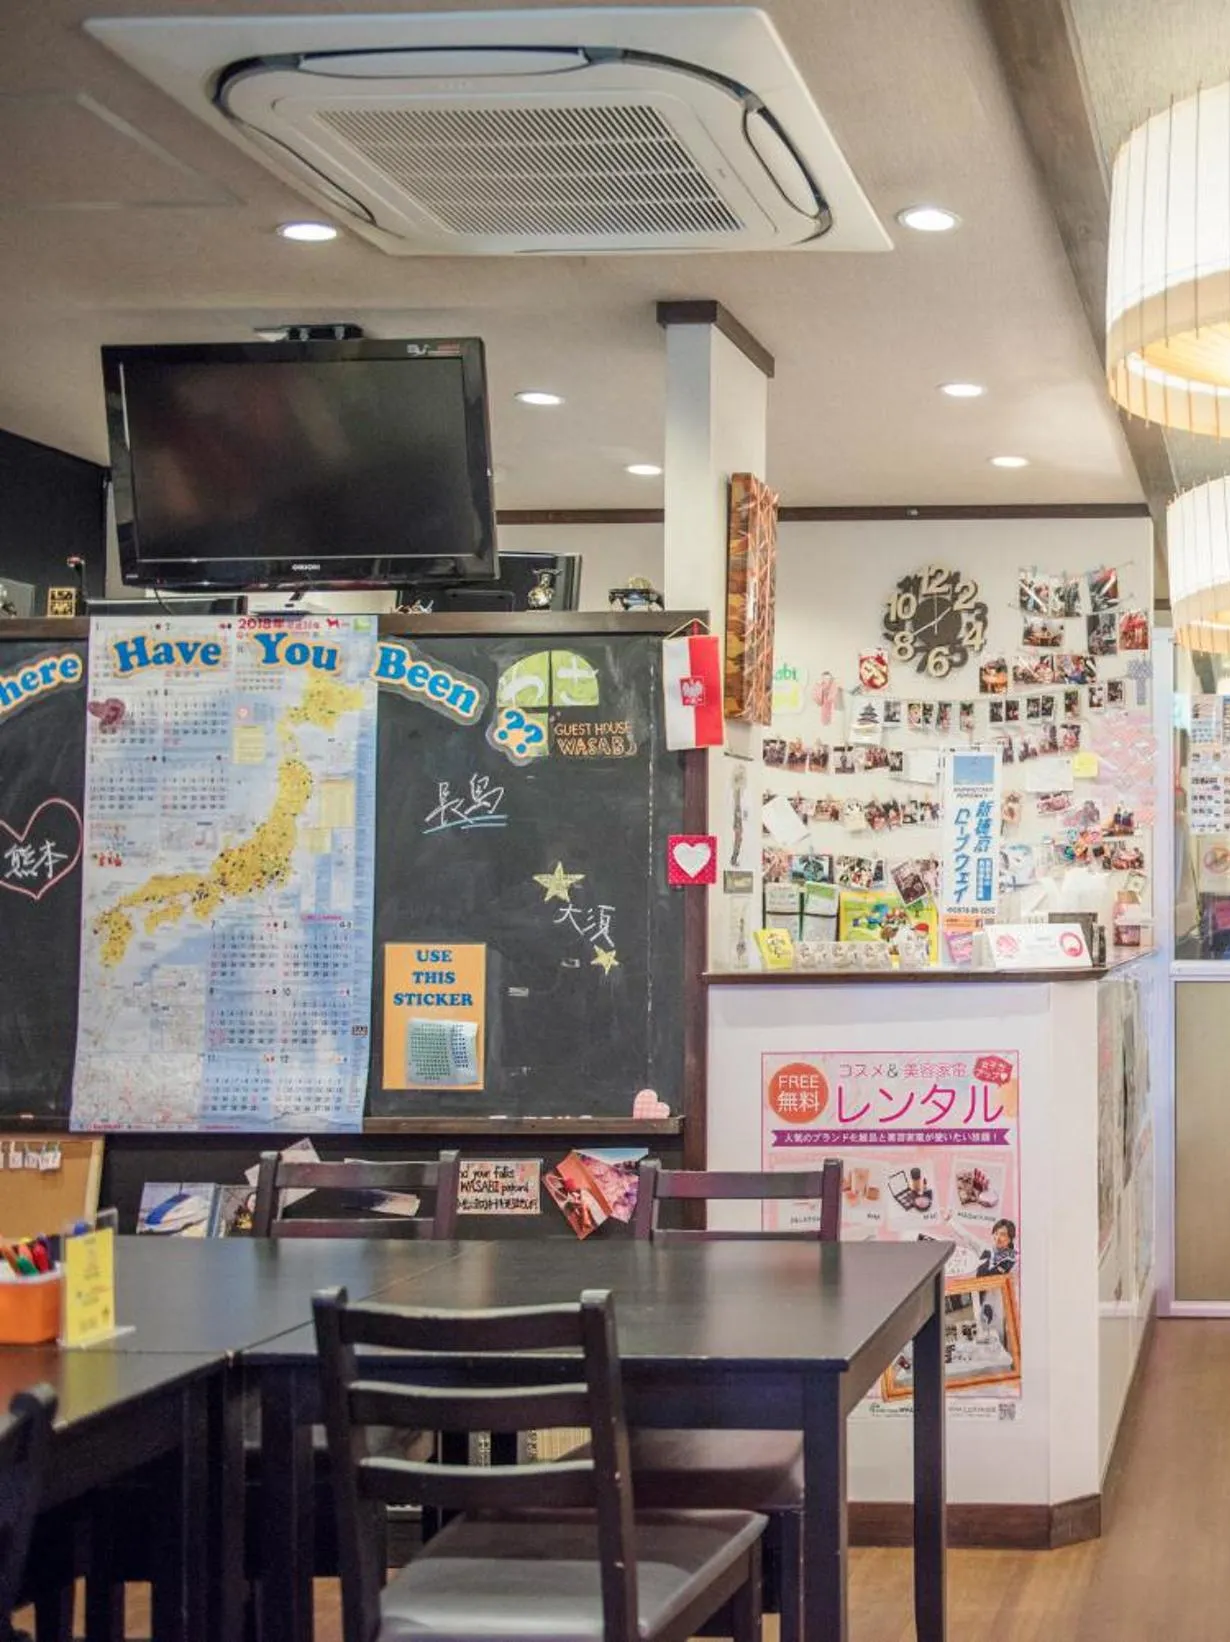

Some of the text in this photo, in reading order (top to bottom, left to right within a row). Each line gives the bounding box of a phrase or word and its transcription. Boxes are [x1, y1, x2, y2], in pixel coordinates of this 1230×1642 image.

[921, 564, 950, 594] 12
[888, 593, 917, 621] 10
[953, 580, 977, 610] 2
[892, 631, 914, 660] 8
[962, 621, 984, 651] 4
[113, 635, 222, 673] Have
[254, 632, 338, 671] You
[375, 646, 477, 714] Been
[927, 646, 949, 677] 6
[554, 722, 592, 736] GUEST
[4, 841, 68, 879] 熊本
[416, 949, 452, 962] USE
[412, 971, 456, 984] THIS
[393, 993, 473, 1006] STICKER
[778, 1075, 819, 1089] FREE
[777, 1091, 820, 1112] 無料
[837, 1084, 1004, 1124] レンタル
